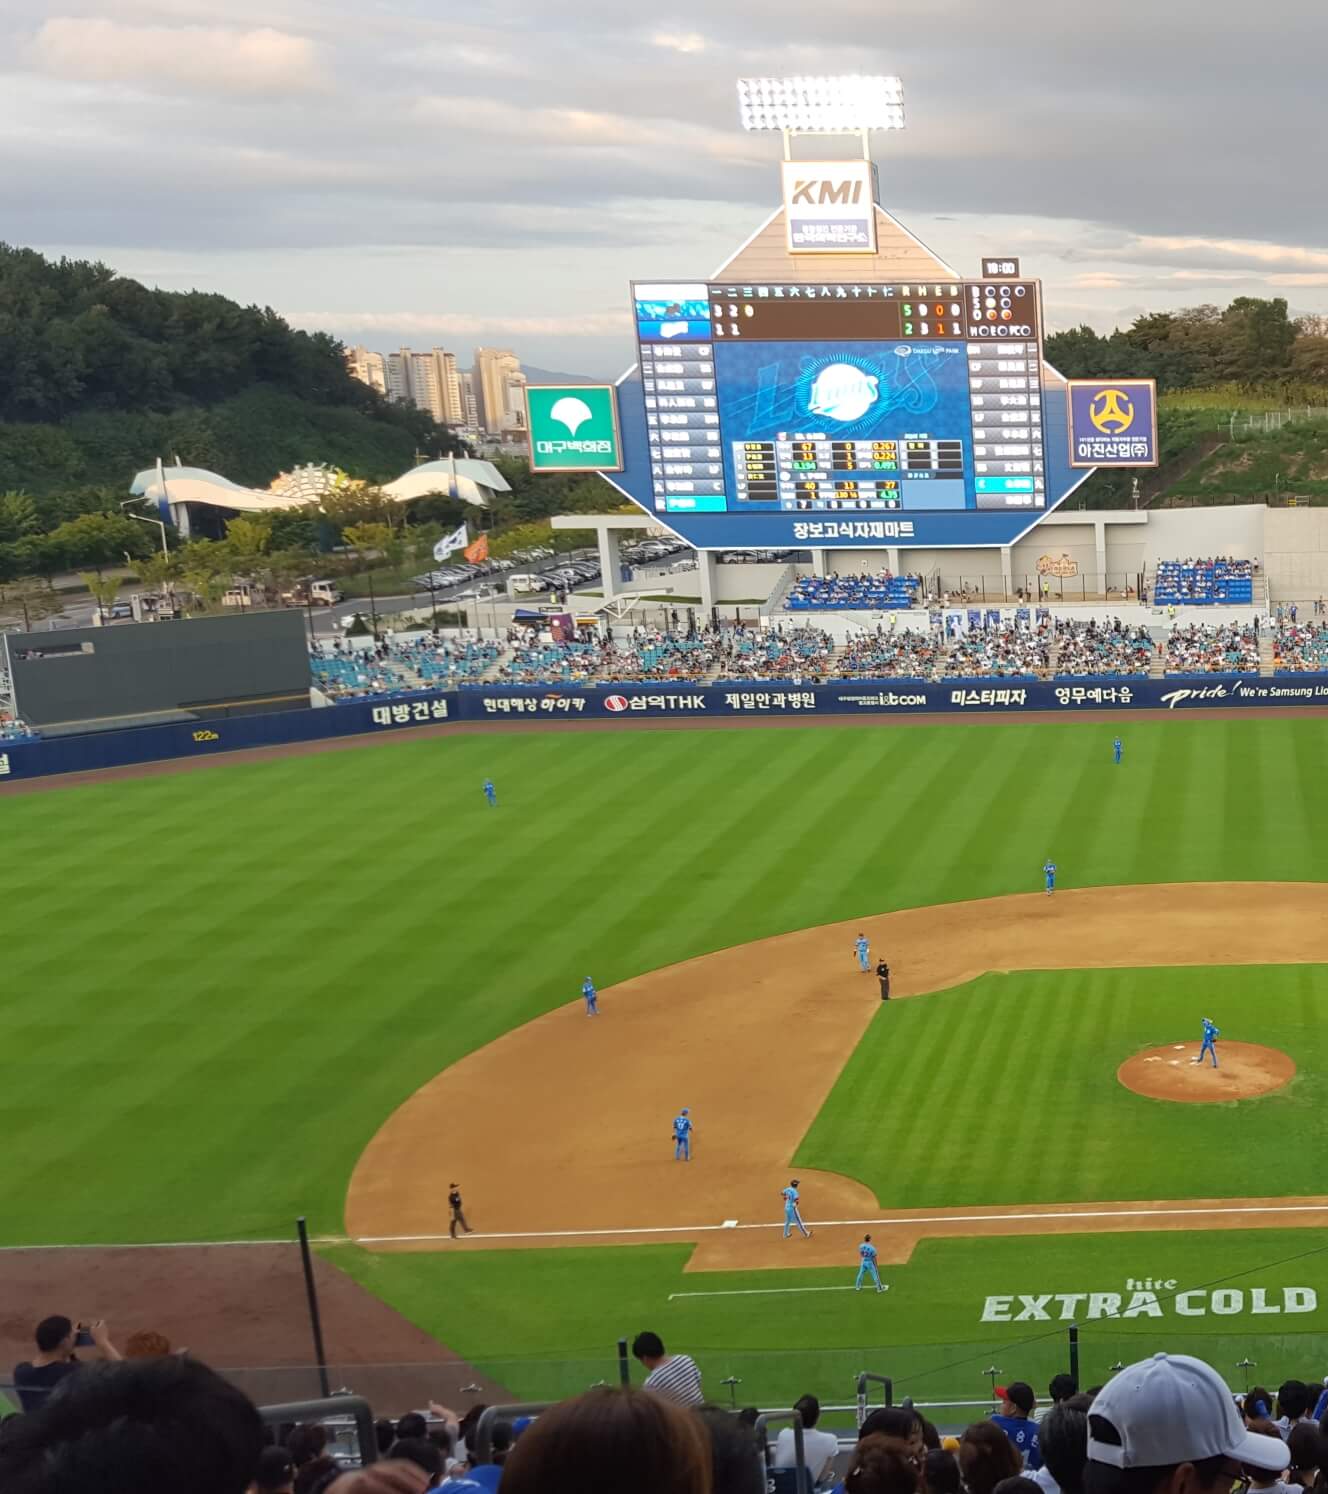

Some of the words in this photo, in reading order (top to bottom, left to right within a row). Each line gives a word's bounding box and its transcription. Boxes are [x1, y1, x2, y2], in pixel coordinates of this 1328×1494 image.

[791, 180, 863, 205] KMI
[727, 288, 738, 297] 二
[743, 287, 753, 297] 三
[790, 286, 800, 297] 六
[805, 286, 816, 298] 七
[820, 286, 831, 297] 八
[902, 286, 911, 296] R
[918, 286, 928, 296] H
[935, 286, 942, 296] E
[950, 286, 958, 296] B
[729, 304, 738, 317] 2
[904, 304, 912, 316] 5
[935, 304, 944, 316] 0
[716, 323, 724, 335] 1
[731, 323, 740, 335] 1
[905, 322, 913, 335] 2
[937, 322, 944, 334] 1
[953, 322, 961, 335] 1
[536, 440, 611, 453] 대구백화점
[846, 442, 851, 450] 0
[873, 442, 895, 450] 0.267
[1078, 443, 1148, 457] 아진산업(주)
[874, 452, 896, 460] 0.224
[793, 521, 914, 539] 장보고식자재마트
[951, 689, 1027, 706] 미스터피자
[1055, 687, 1134, 705] 영무예다음
[1240, 686, 1267, 698] We're
[1269, 685, 1313, 698] Samsung
[541, 697, 585, 712] 하이카
[629, 695, 706, 710] 삼익THK
[725, 692, 806, 709] 제일안과병원
[372, 699, 449, 725] 대방건설
[1126, 1277, 1177, 1291] hite
[980, 1292, 1163, 1322] EXTRA
[1175, 1287, 1317, 1316] COLD
